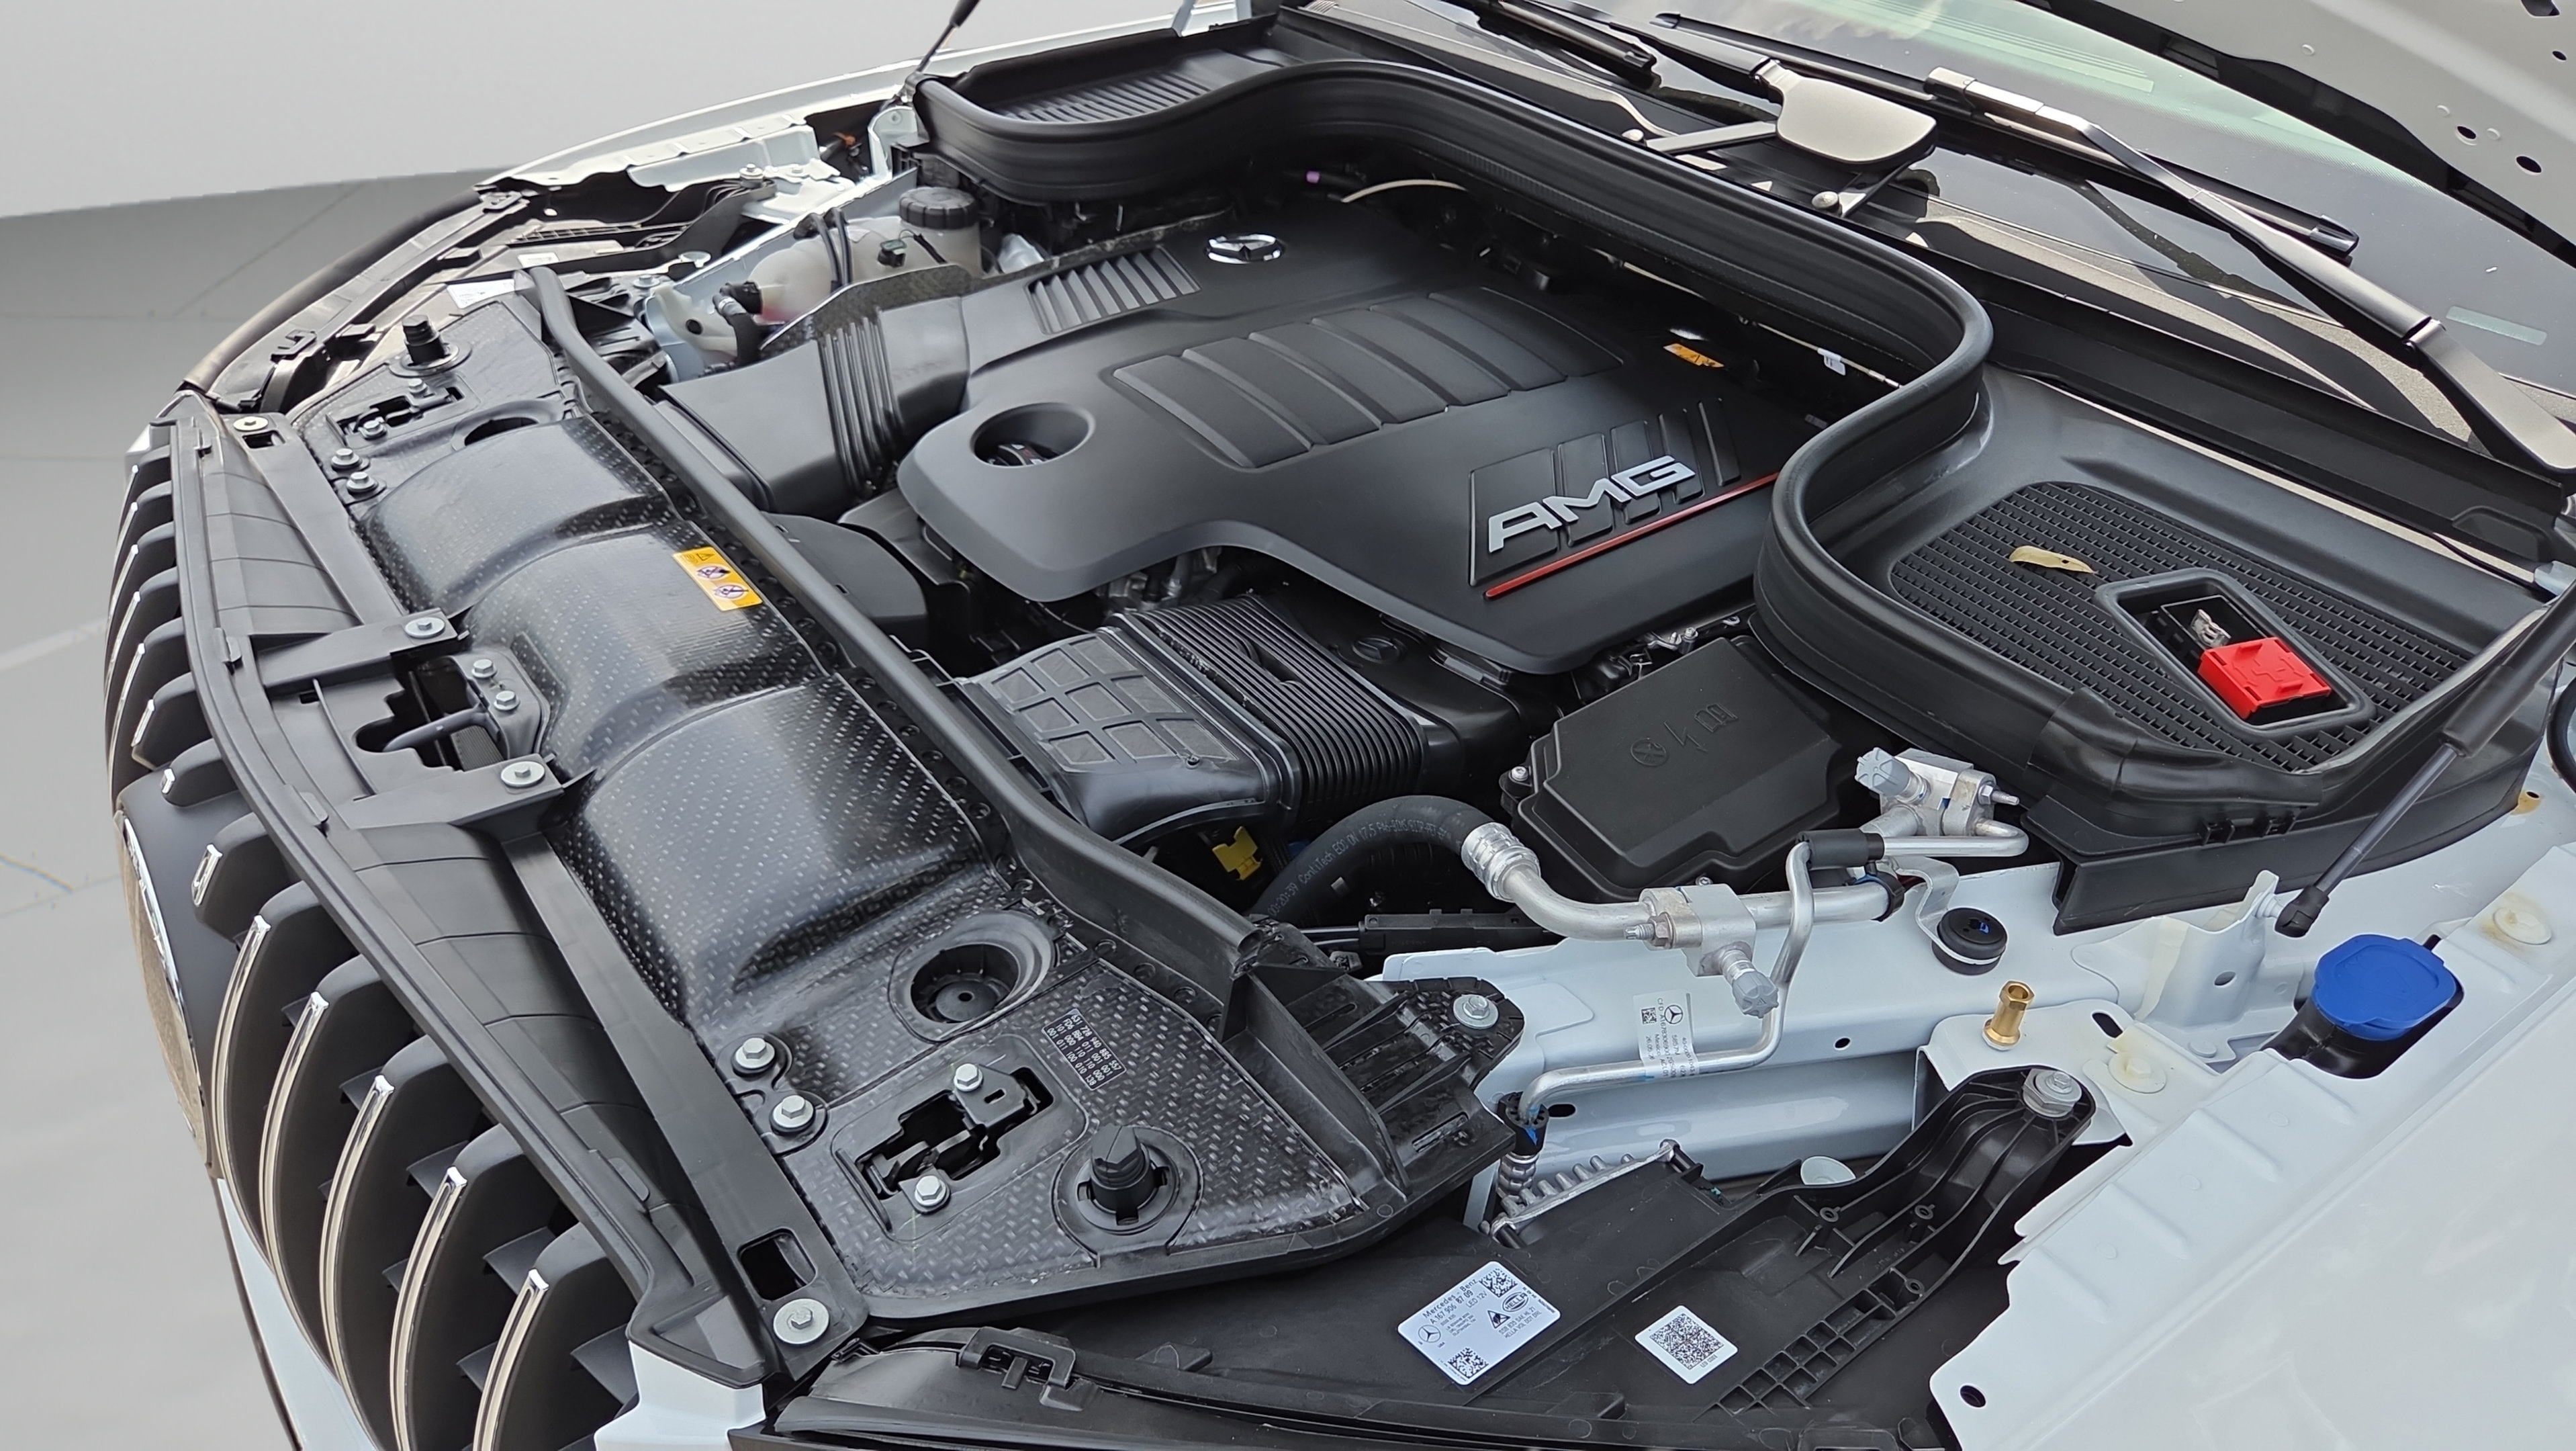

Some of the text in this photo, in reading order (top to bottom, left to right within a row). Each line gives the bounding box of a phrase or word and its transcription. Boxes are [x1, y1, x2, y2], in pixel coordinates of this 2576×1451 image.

[1488, 455, 1696, 554] AMG
[1046, 1027, 1097, 1086] 001 011 100 010 138
[1055, 1023, 1105, 1080] 101 000 110 110 000
[1080, 1025, 1092, 1037] 728
[1089, 1037, 1101, 1047] 940
[1099, 1048, 1111, 1059] 885
[1108, 1059, 1121, 1070] 557
[1081, 1041, 1093, 1052] 011
[1091, 1053, 1103, 1063] 001
[1100, 1064, 1113, 1075] 001
[1422, 1294, 1456, 1318] Mercedes
[1460, 1279, 1477, 1292] Benz
[1434, 1311, 1445, 1320] 167
[1444, 1303, 1457, 1313] 906
[1455, 1295, 1464, 1304] 87
[1464, 1289, 1473, 1299] 09
[1466, 1290, 1487, 1308] LED 12V
[1505, 1292, 1528, 1310] HELLA
